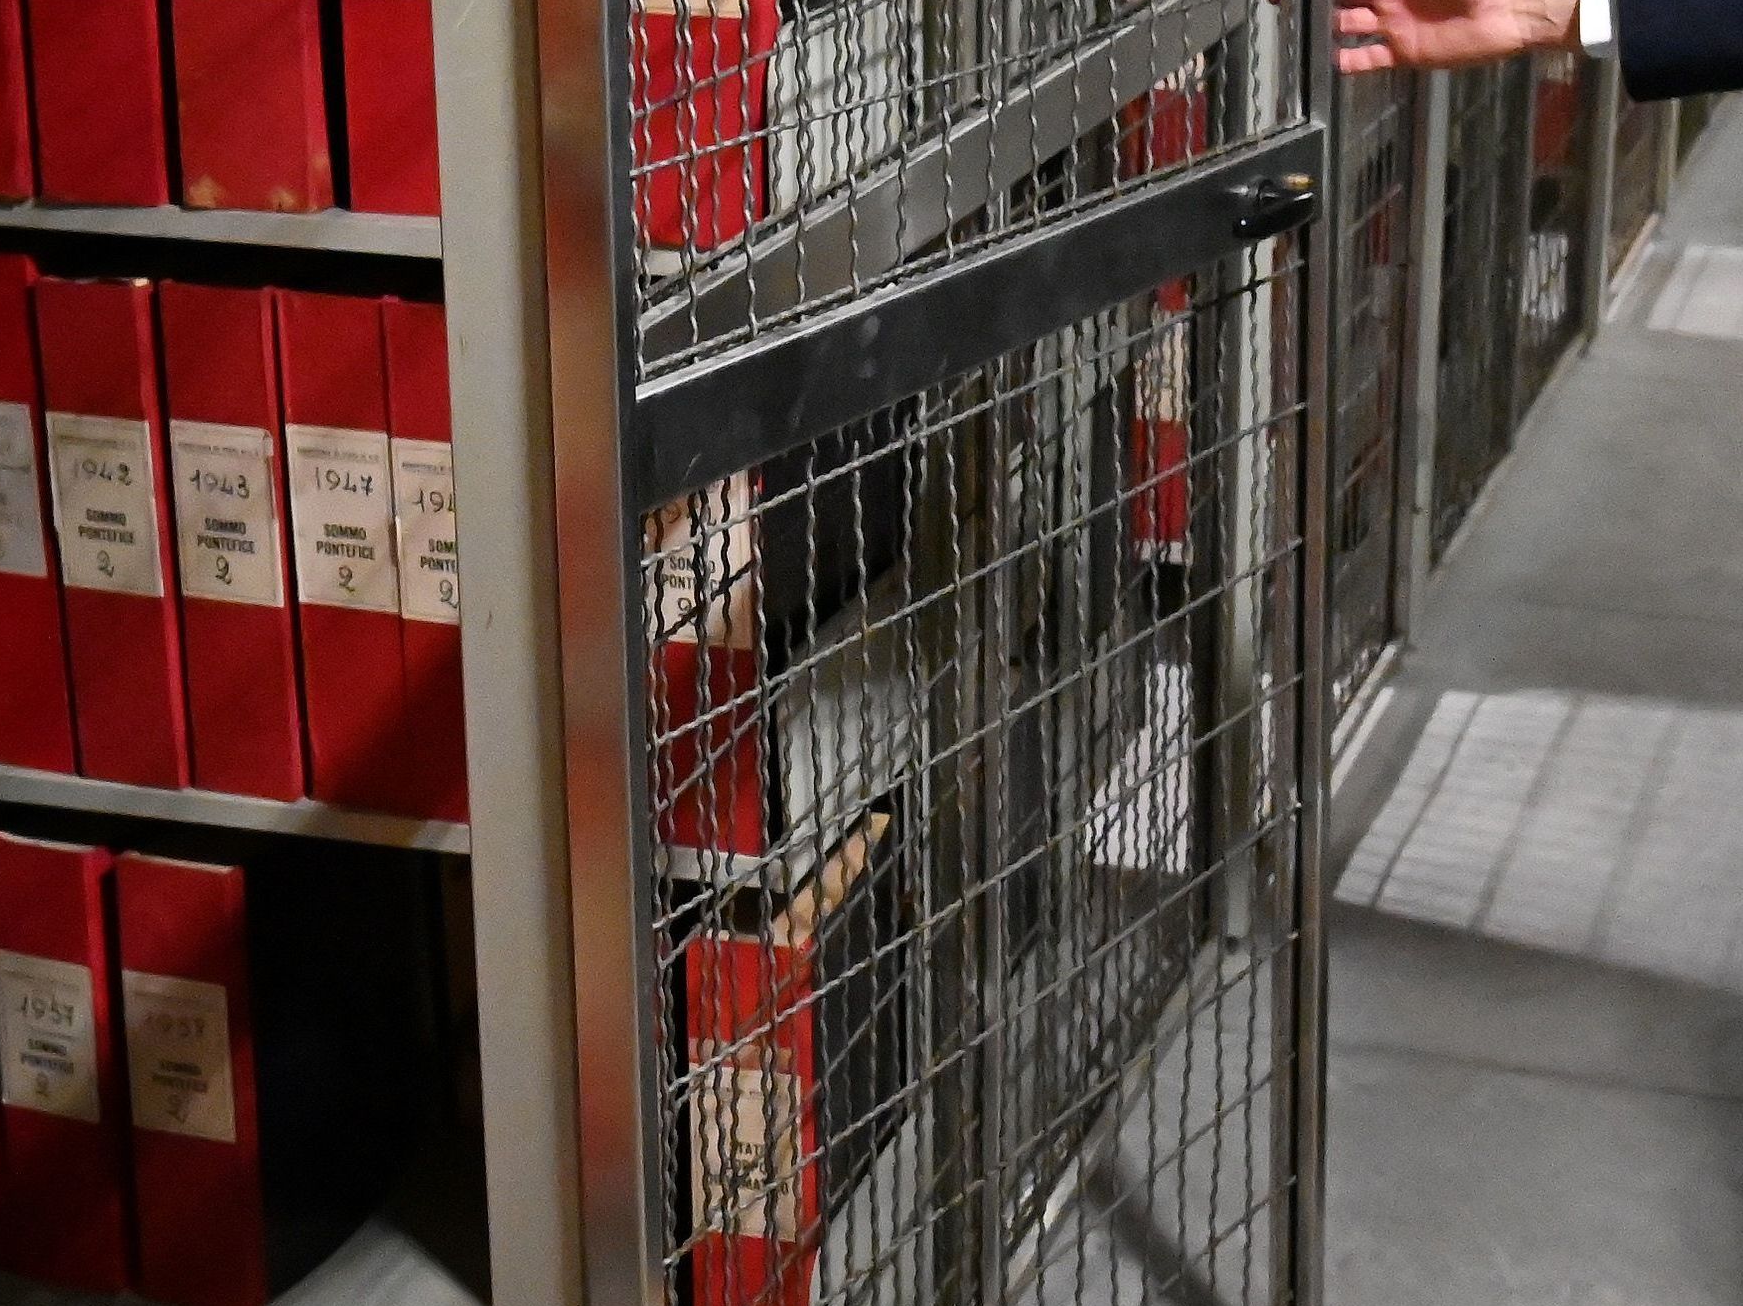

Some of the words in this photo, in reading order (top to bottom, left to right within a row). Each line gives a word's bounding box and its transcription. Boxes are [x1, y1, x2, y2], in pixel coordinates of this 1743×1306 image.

[73, 457, 133, 487] 1942
[189, 469, 251, 499] 1943
[315, 466, 374, 497] 1947
[412, 488, 456, 514] 194
[85, 508, 127, 527] SOMMO
[204, 517, 247, 535] SOMMO
[197, 535, 256, 554] PONTEFICE
[322, 523, 367, 542] SOMMO
[428, 537, 456, 554] SOM
[316, 540, 376, 560] PONTEFICE
[96, 549, 115, 578] 2
[214, 554, 233, 586] 2
[338, 564, 356, 593] 2
